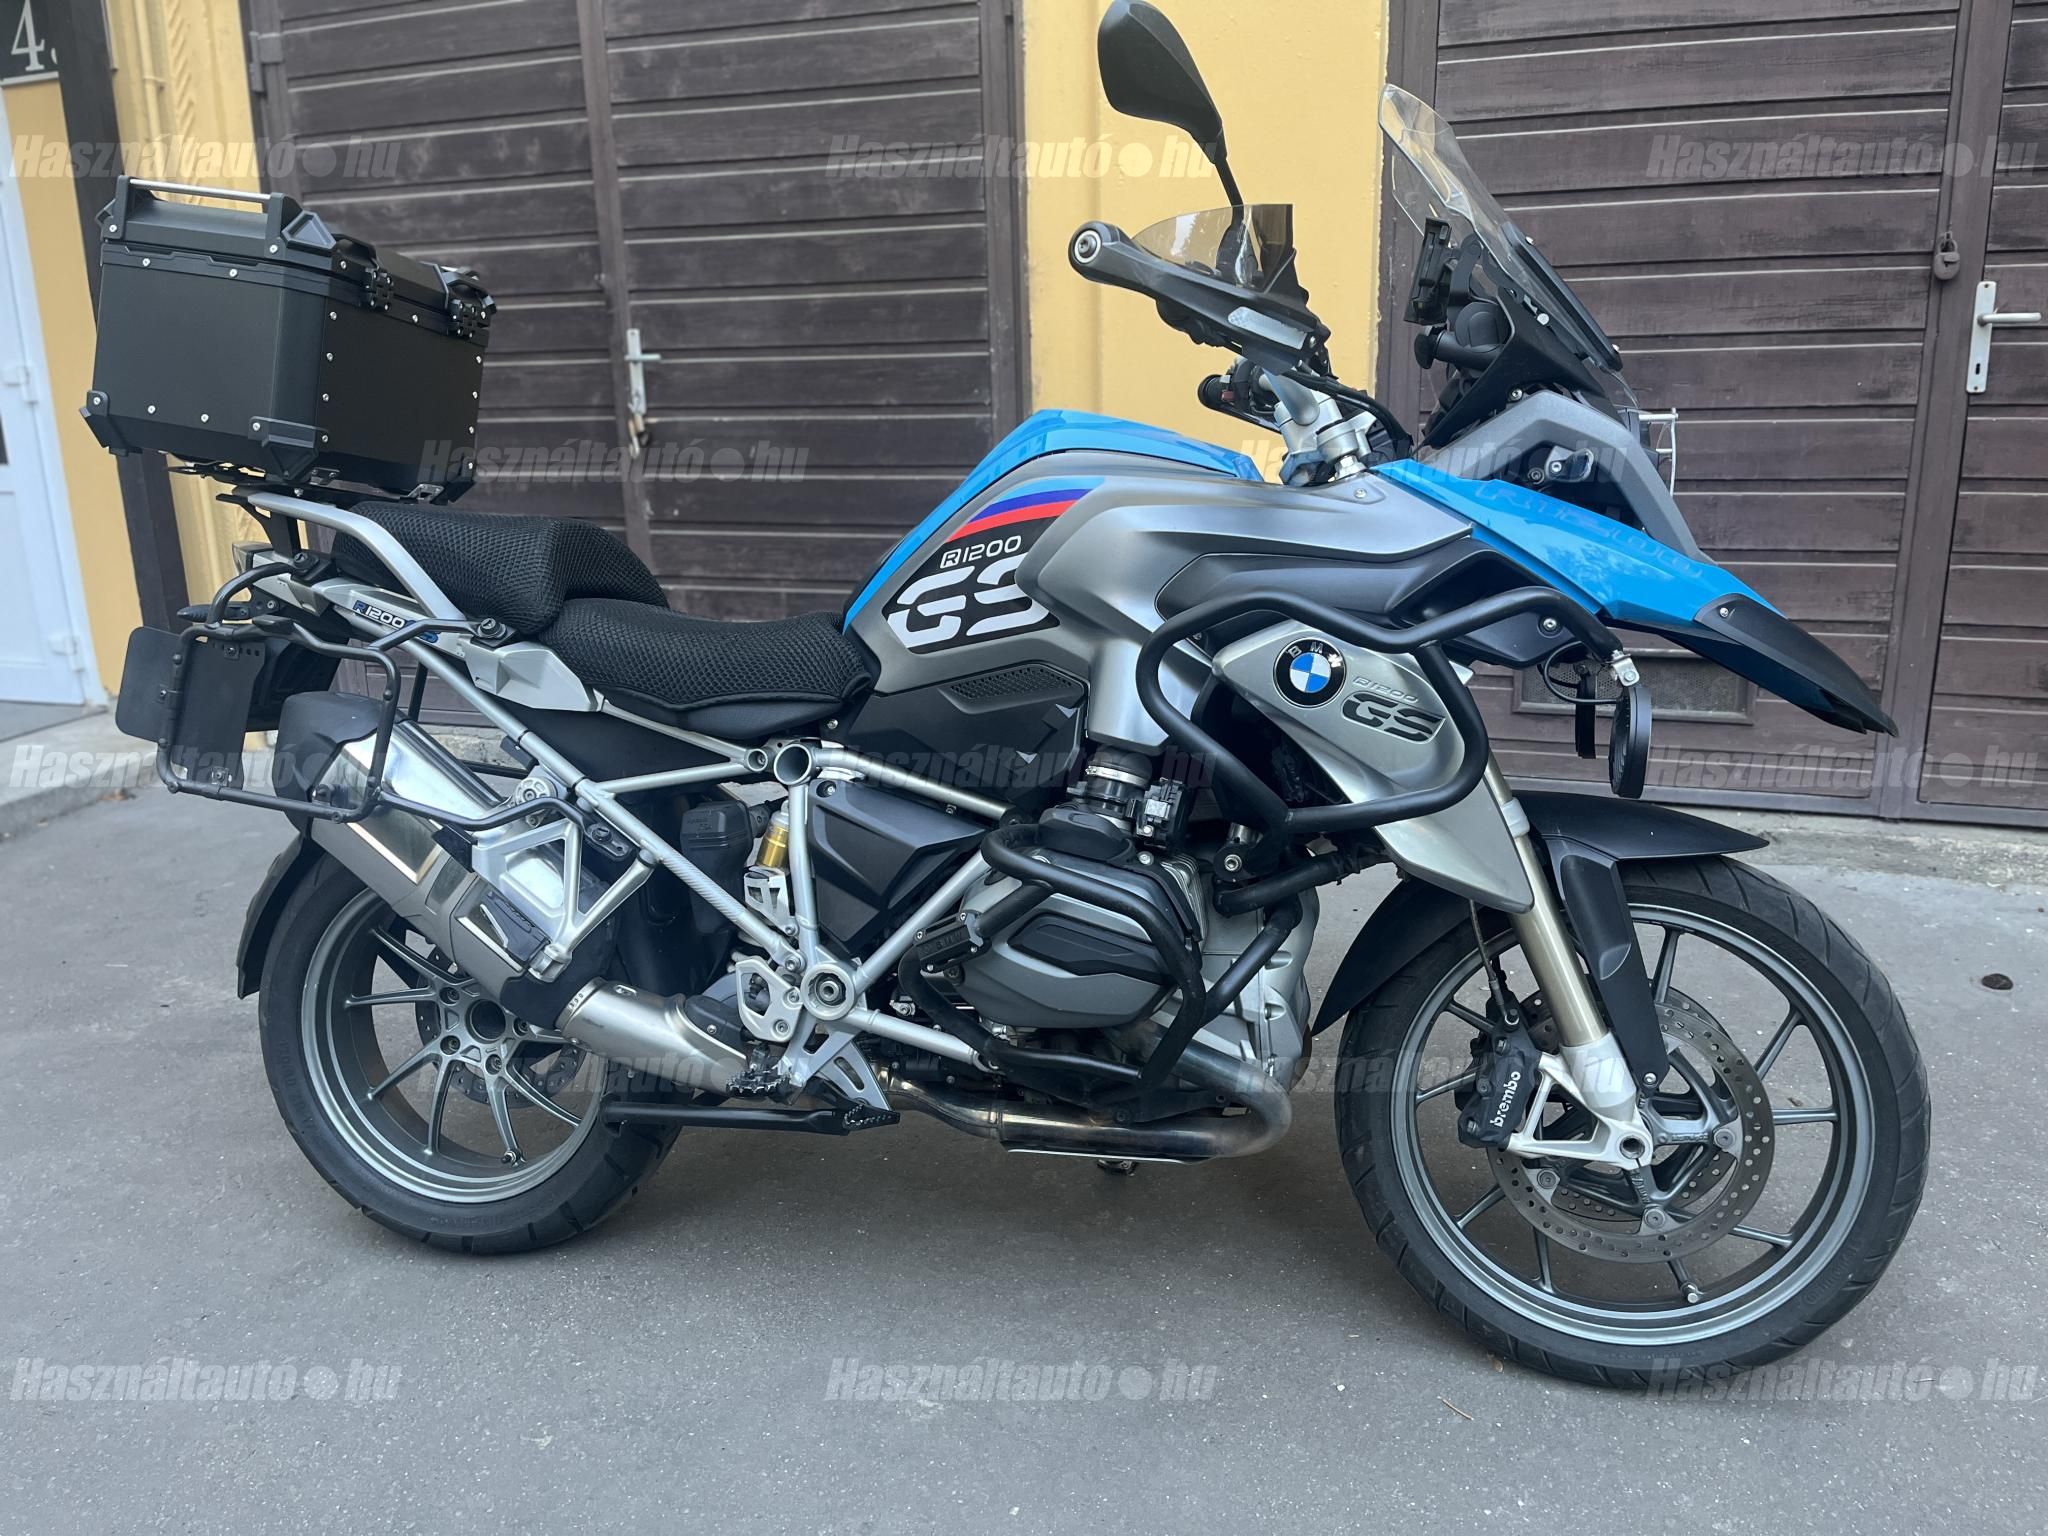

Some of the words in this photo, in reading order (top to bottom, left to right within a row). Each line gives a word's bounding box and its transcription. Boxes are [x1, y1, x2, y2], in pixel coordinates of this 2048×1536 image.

[940, 535, 1022, 569] R1200
[887, 552, 1050, 649] GS
[1285, 641, 1344, 669] BMW
[1342, 692, 1445, 742] GS
[1489, 1070, 1522, 1128] brembo
